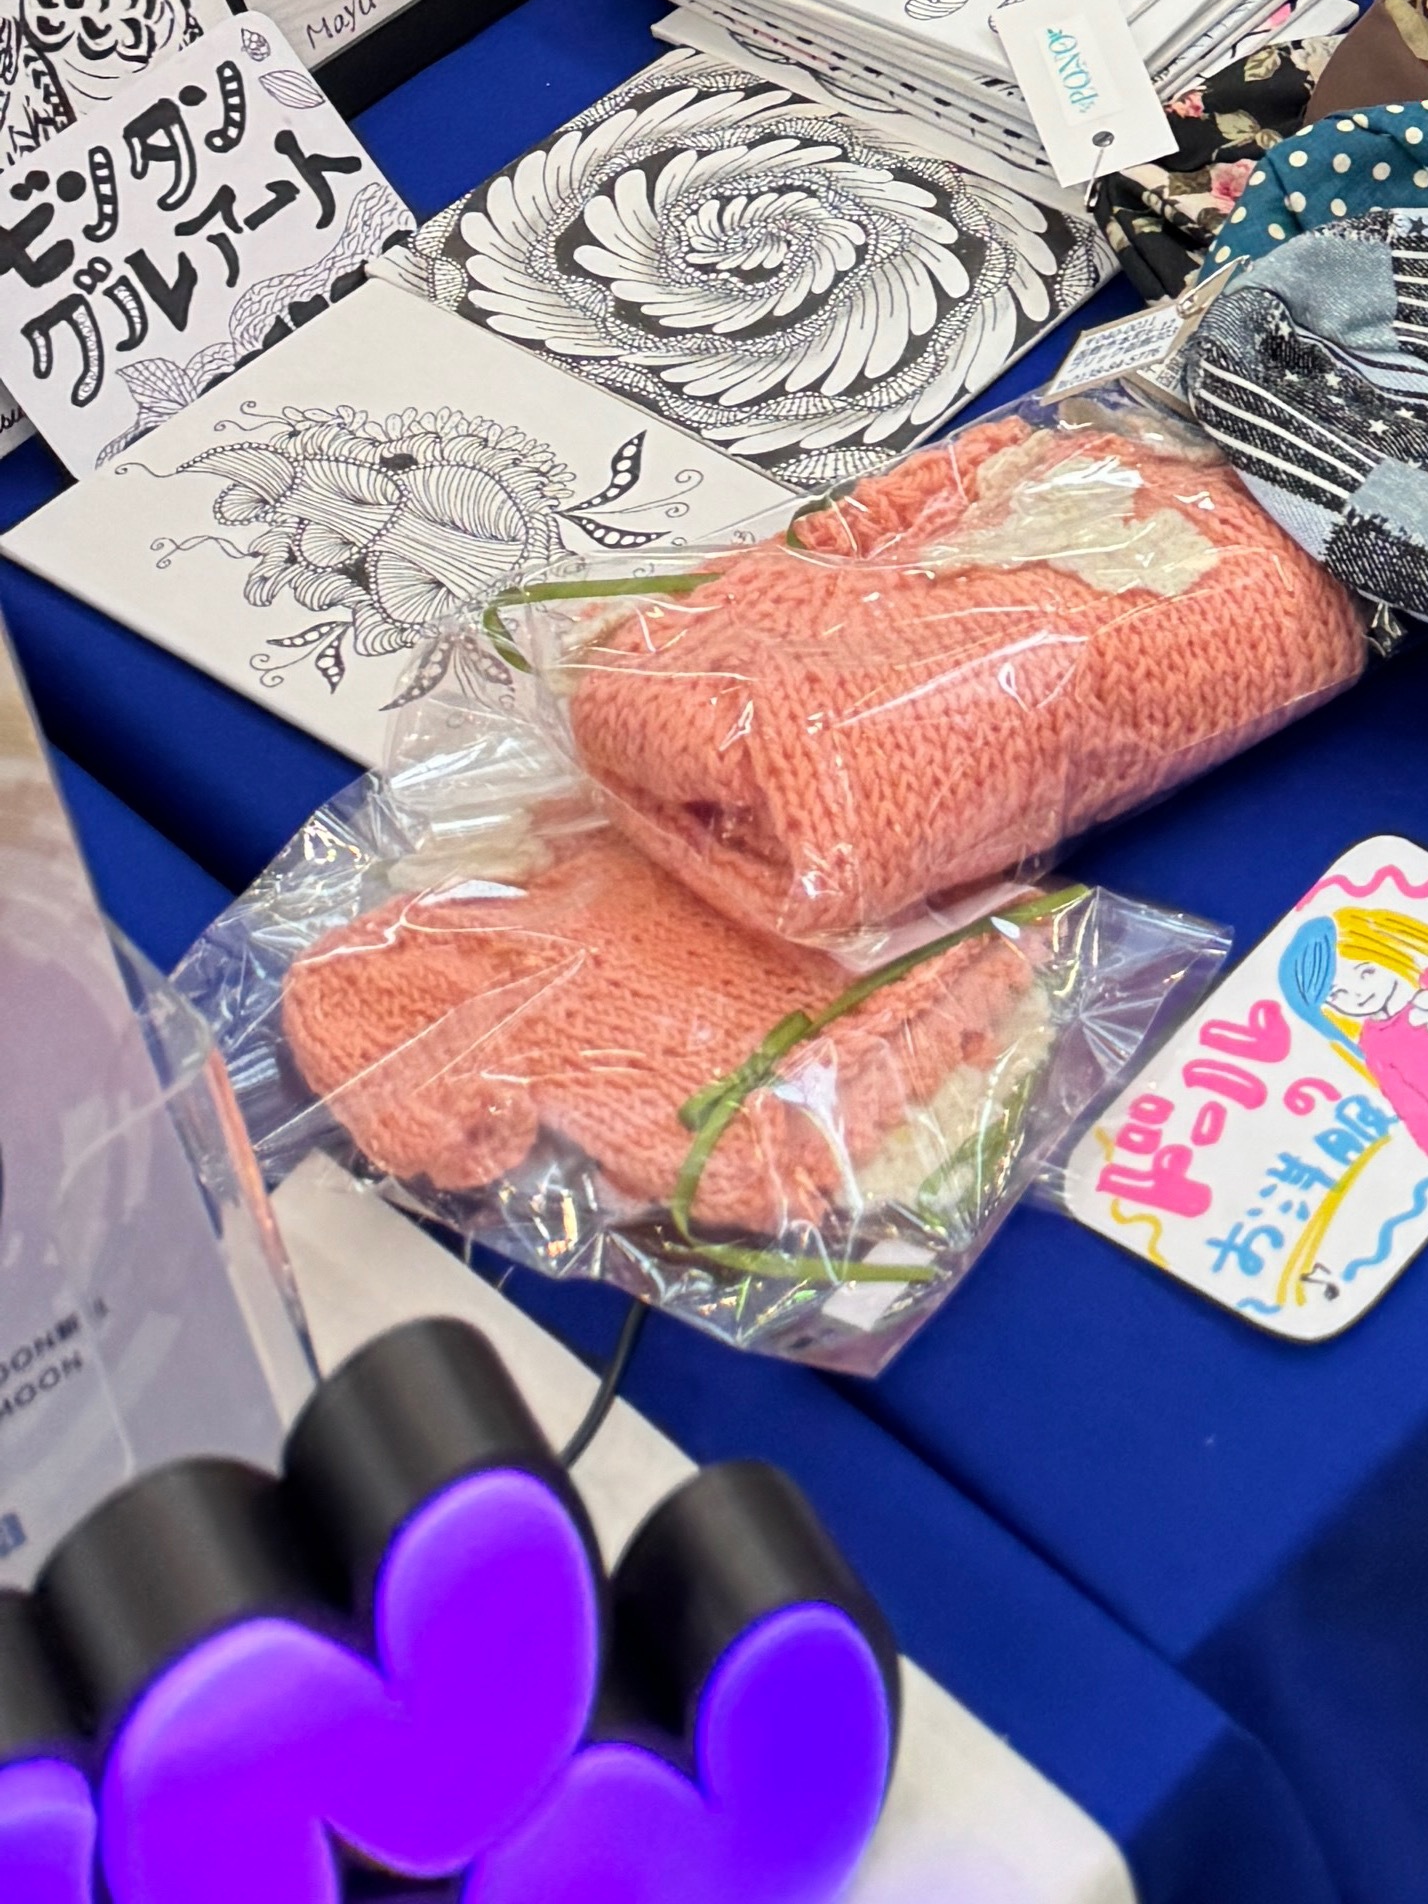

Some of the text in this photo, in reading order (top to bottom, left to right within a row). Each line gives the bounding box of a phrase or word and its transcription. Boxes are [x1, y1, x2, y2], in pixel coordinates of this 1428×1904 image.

[1046, 27, 1100, 115] PONO
[20, 130, 364, 409] グルアート
[1095, 998, 1342, 1219] パールの
[1203, 1093, 1402, 1277] お洋服
